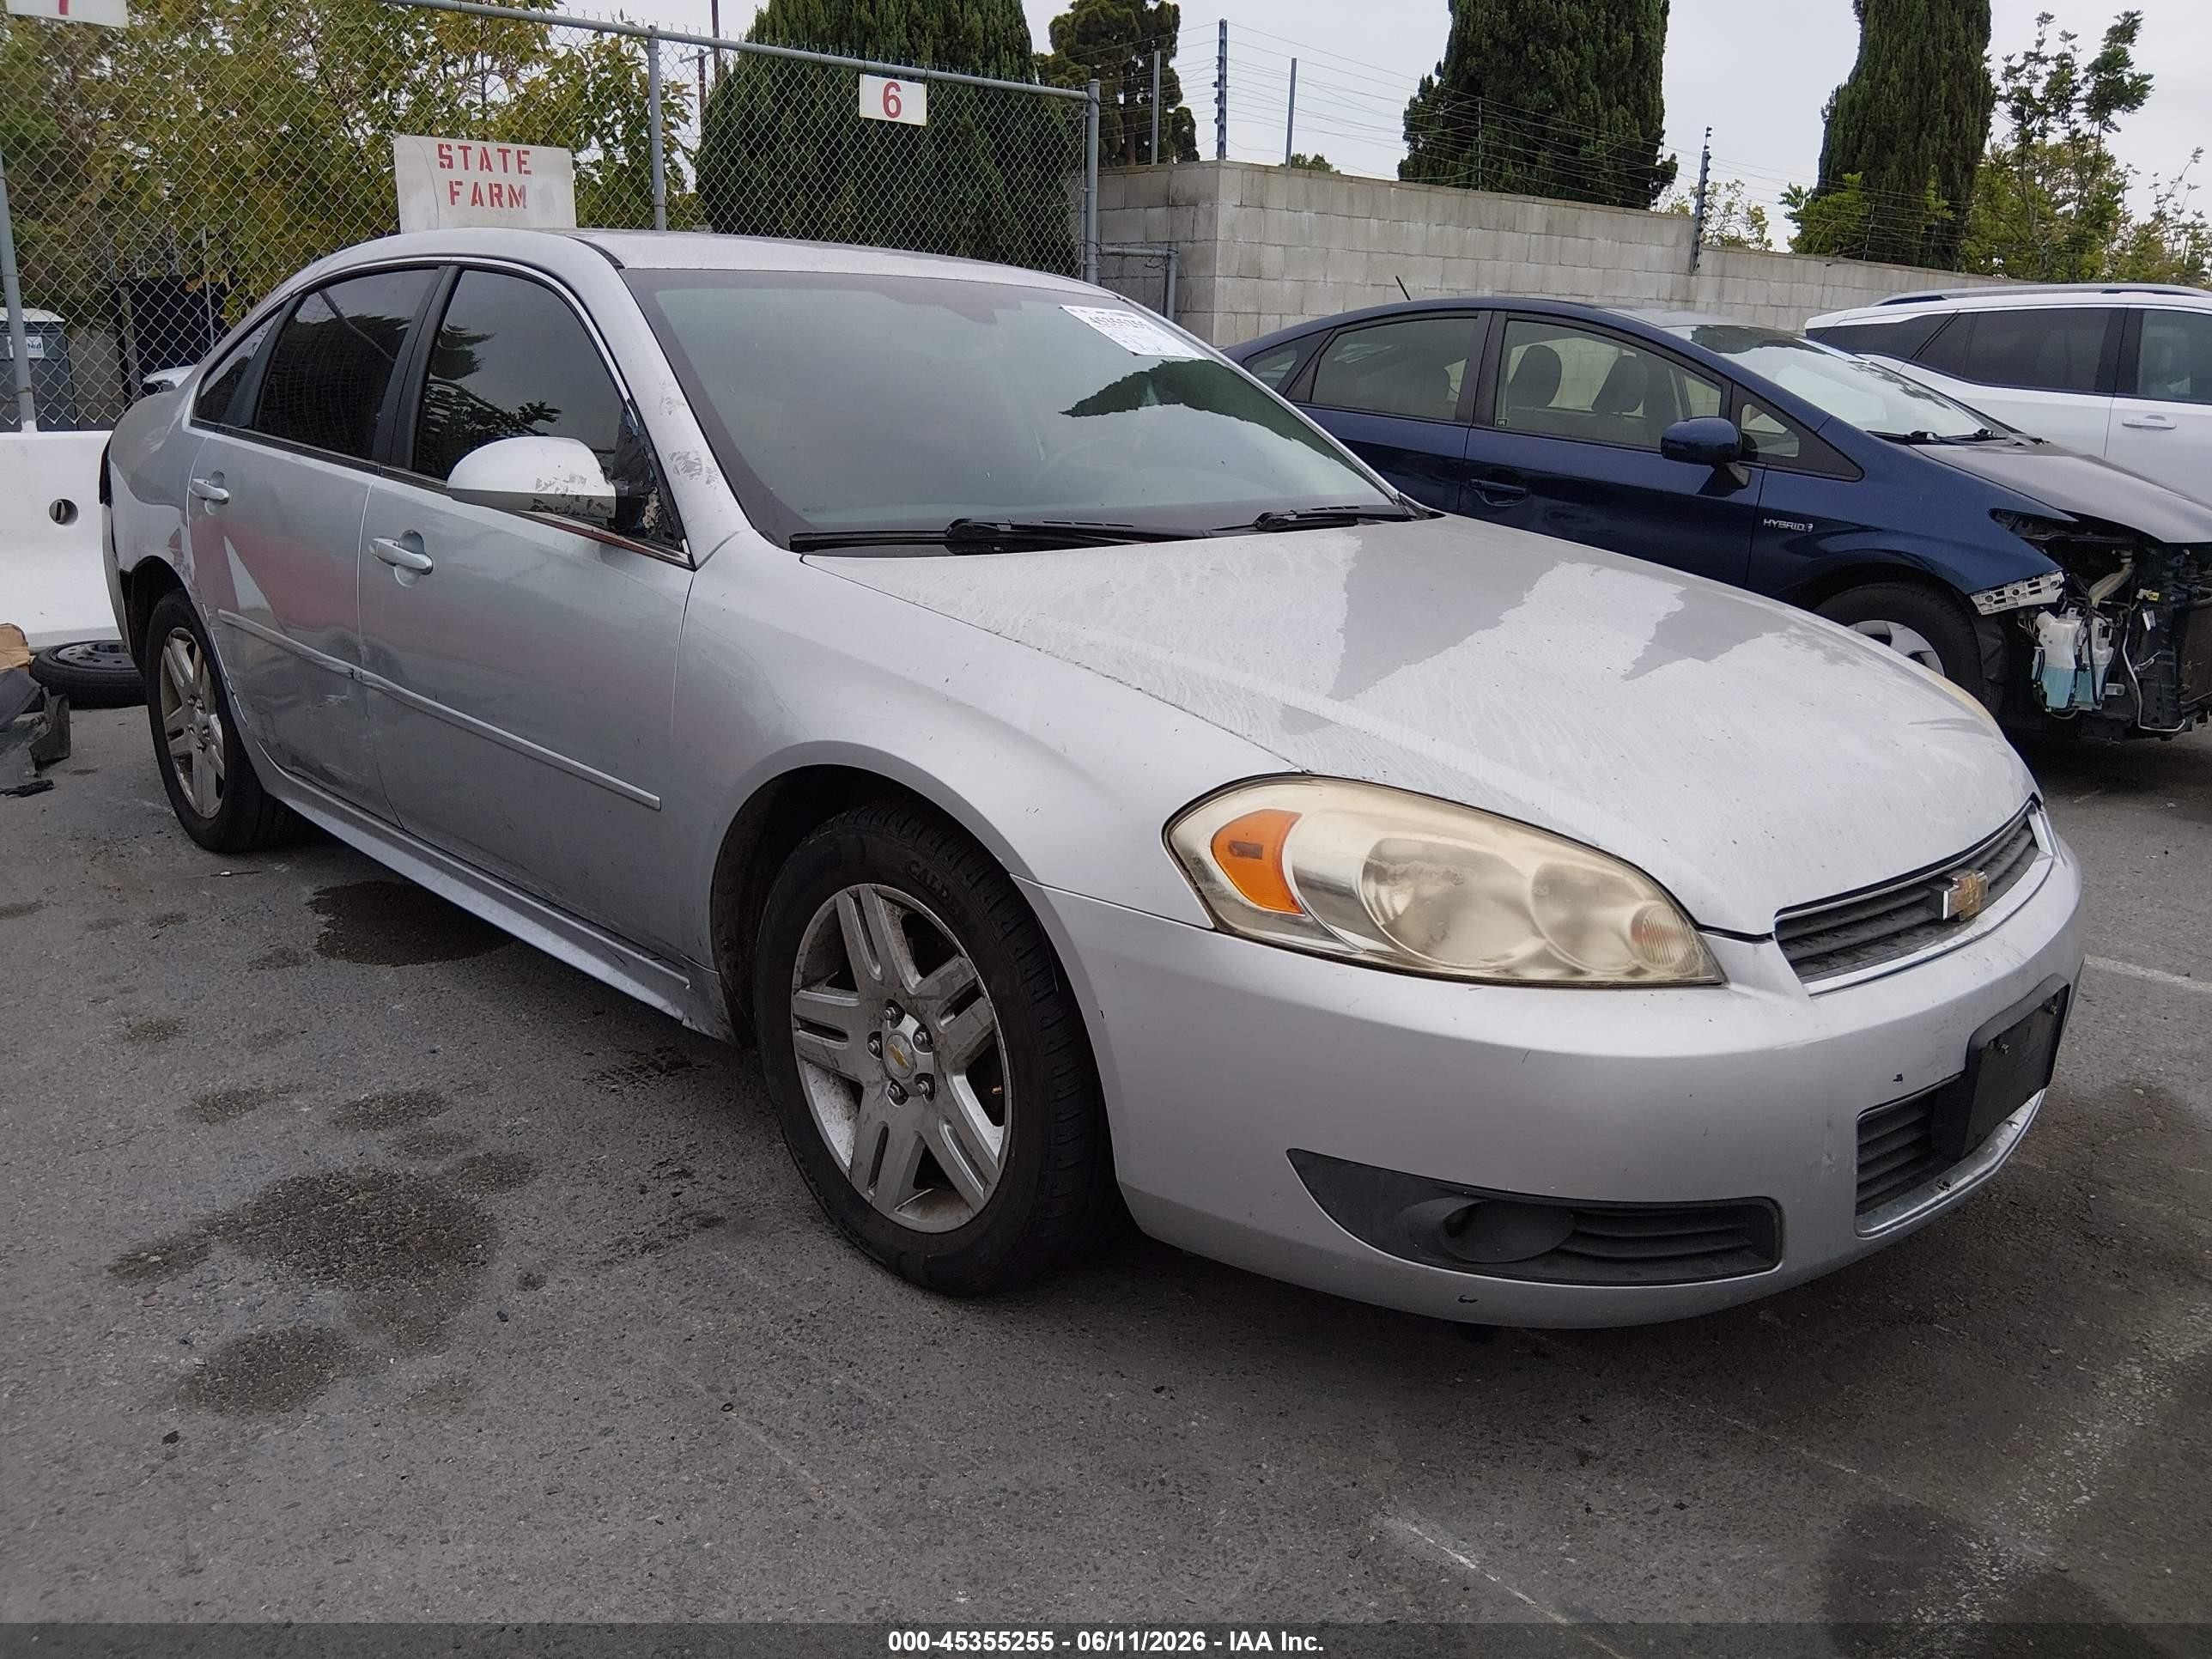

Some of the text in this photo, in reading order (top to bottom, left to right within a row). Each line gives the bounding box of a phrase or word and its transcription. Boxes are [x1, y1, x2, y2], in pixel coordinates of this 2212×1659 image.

[883, 82, 902, 118] 6
[438, 143, 532, 175] STATE
[449, 180, 527, 210] FARM
[1763, 518, 1806, 532] HYBRID
